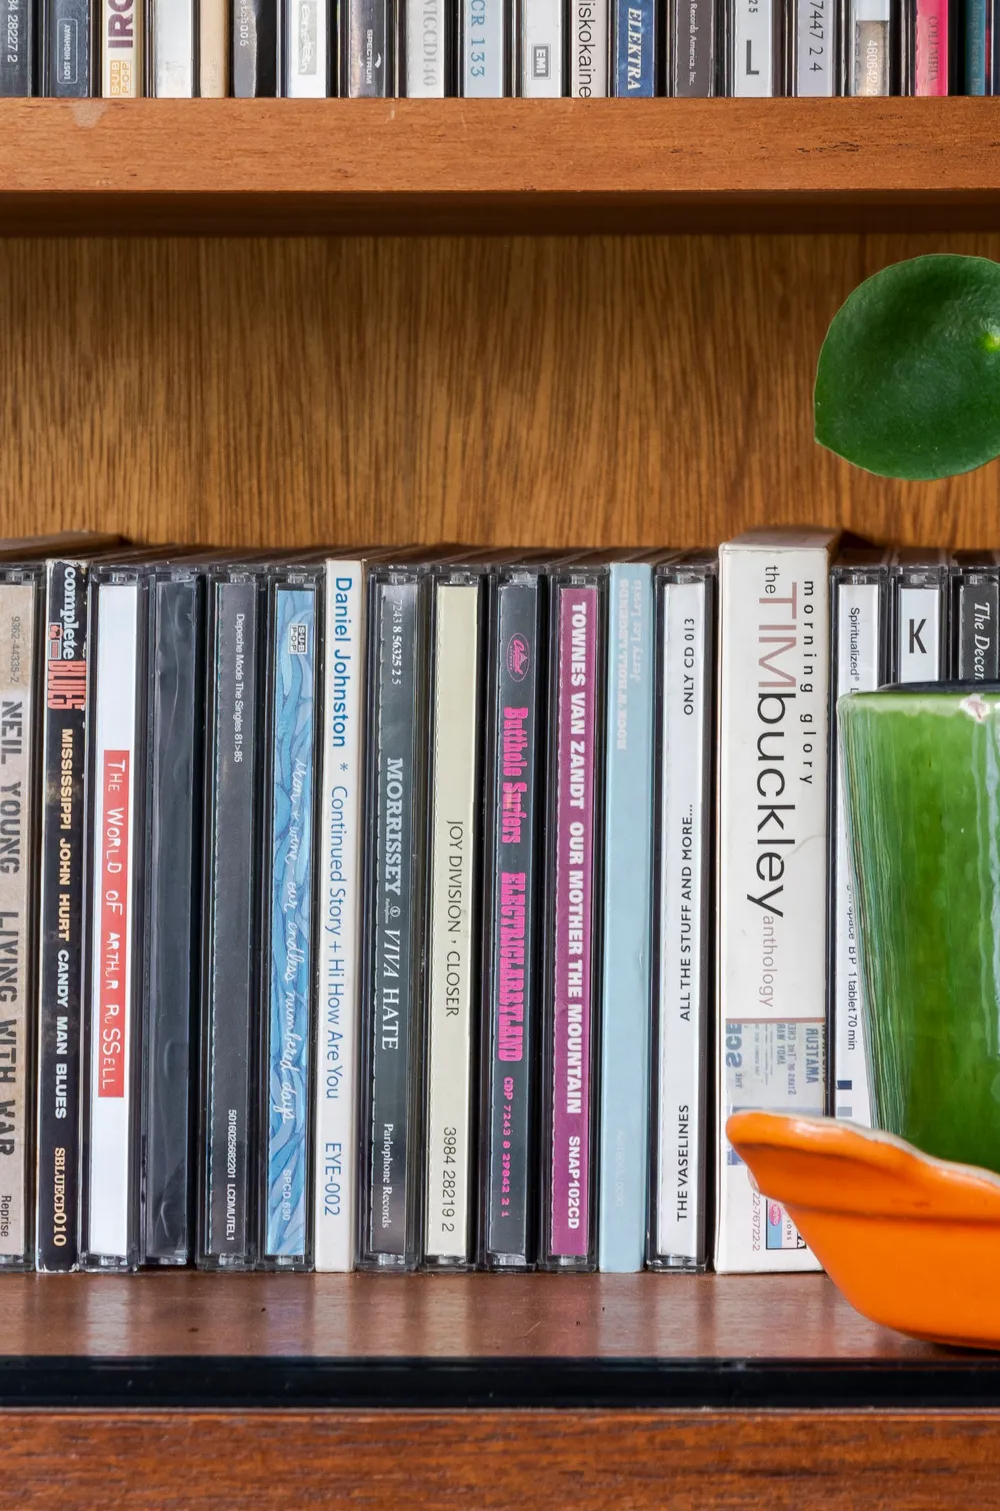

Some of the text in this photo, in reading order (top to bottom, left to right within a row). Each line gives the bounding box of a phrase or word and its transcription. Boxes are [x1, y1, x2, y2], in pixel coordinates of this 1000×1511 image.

[7, 14, 18, 51] 28227
[63, 24, 71, 80] LOST HIGHWAY
[471, 38, 486, 78] 133
[536, 49, 546, 74] EMI
[627, 7, 643, 90] ELEKTRA
[689, 4, 699, 34] Records
[866, 39, 878, 83] 460642
[9, 616, 21, 683] 9362-44335-2
[59, 567, 79, 660] complete
[391, 599, 402, 666] 7243 56325
[974, 601, 990, 631] The
[47, 660, 86, 710] BLUES
[233, 613, 245, 732] Depeche Mode The Singles
[683, 647, 694, 715] ONLY CD
[0, 700, 23, 874] NEIL YOUNG
[105, 759, 126, 874] THE WORLD
[501, 707, 529, 843] Butthole Surfers
[324, 576, 353, 1099] Daniel Johnston Continued Story Hi How Are You
[384, 757, 403, 896] MORRISSEY
[566, 602, 587, 1113] TOWNES VAN ZANDT OUR MOTHER THE MOUNTAIN
[55, 728, 74, 1119] MISSISSIPPI JOHN HURT CANDY MAN BLUES
[445, 820, 464, 1017] JOY DIVISION CLOSER
[680, 867, 692, 1022] ALL THE STUFF AND
[381, 929, 400, 1050] VIVA HATE
[847, 980, 857, 1050] tablet min
[503, 1076, 514, 1099] CDP
[225, 1109, 237, 1241] 5016025682201 LCDMUTEL1
[324, 1142, 342, 1216] EYE-002
[381, 1123, 394, 1228] Parlophone Records
[441, 1126, 457, 1217] 3984 28219
[568, 1136, 580, 1229] SNAP102CD
[676, 1105, 689, 1222] THE VASELINES
